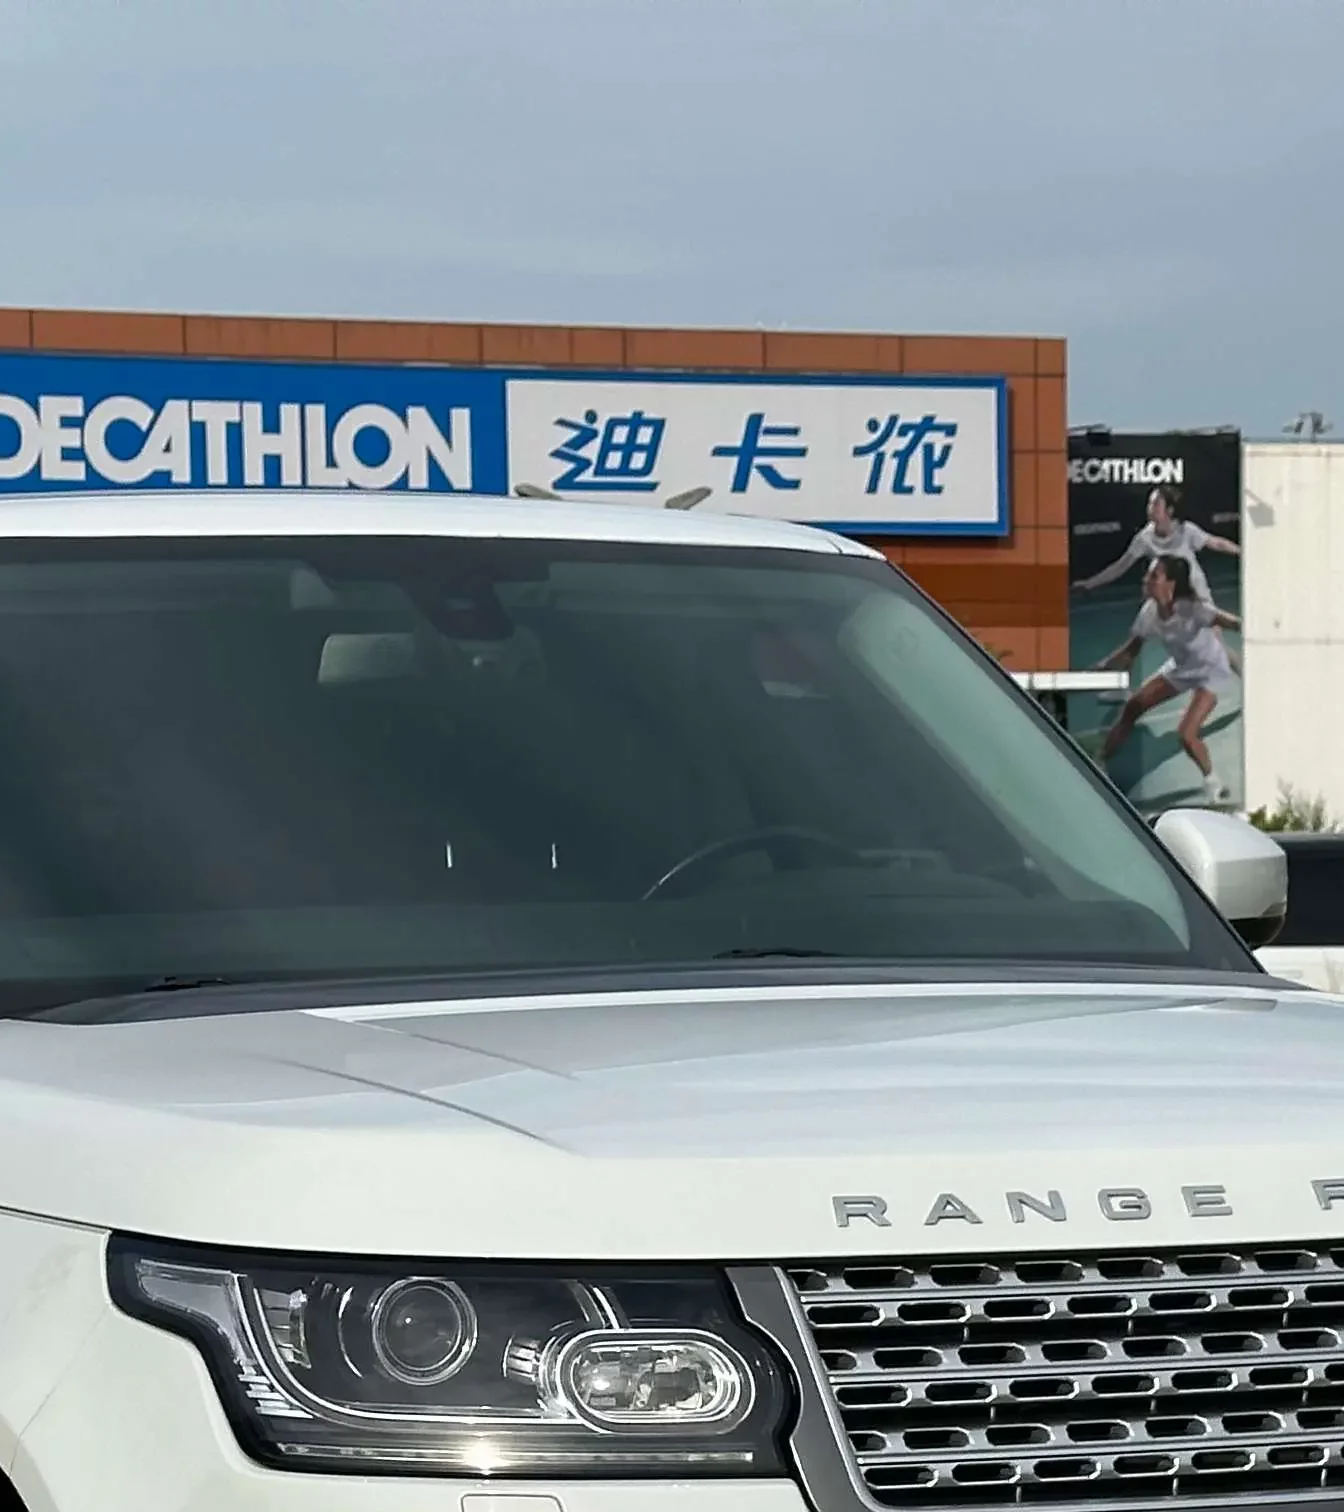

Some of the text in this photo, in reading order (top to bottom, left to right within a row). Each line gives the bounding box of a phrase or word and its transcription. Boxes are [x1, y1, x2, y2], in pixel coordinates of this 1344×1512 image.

[548, 409, 959, 496] 迪卡侬
[1068, 457, 1185, 484] ECATHLON
[832, 1184, 1234, 1227] RANGE
